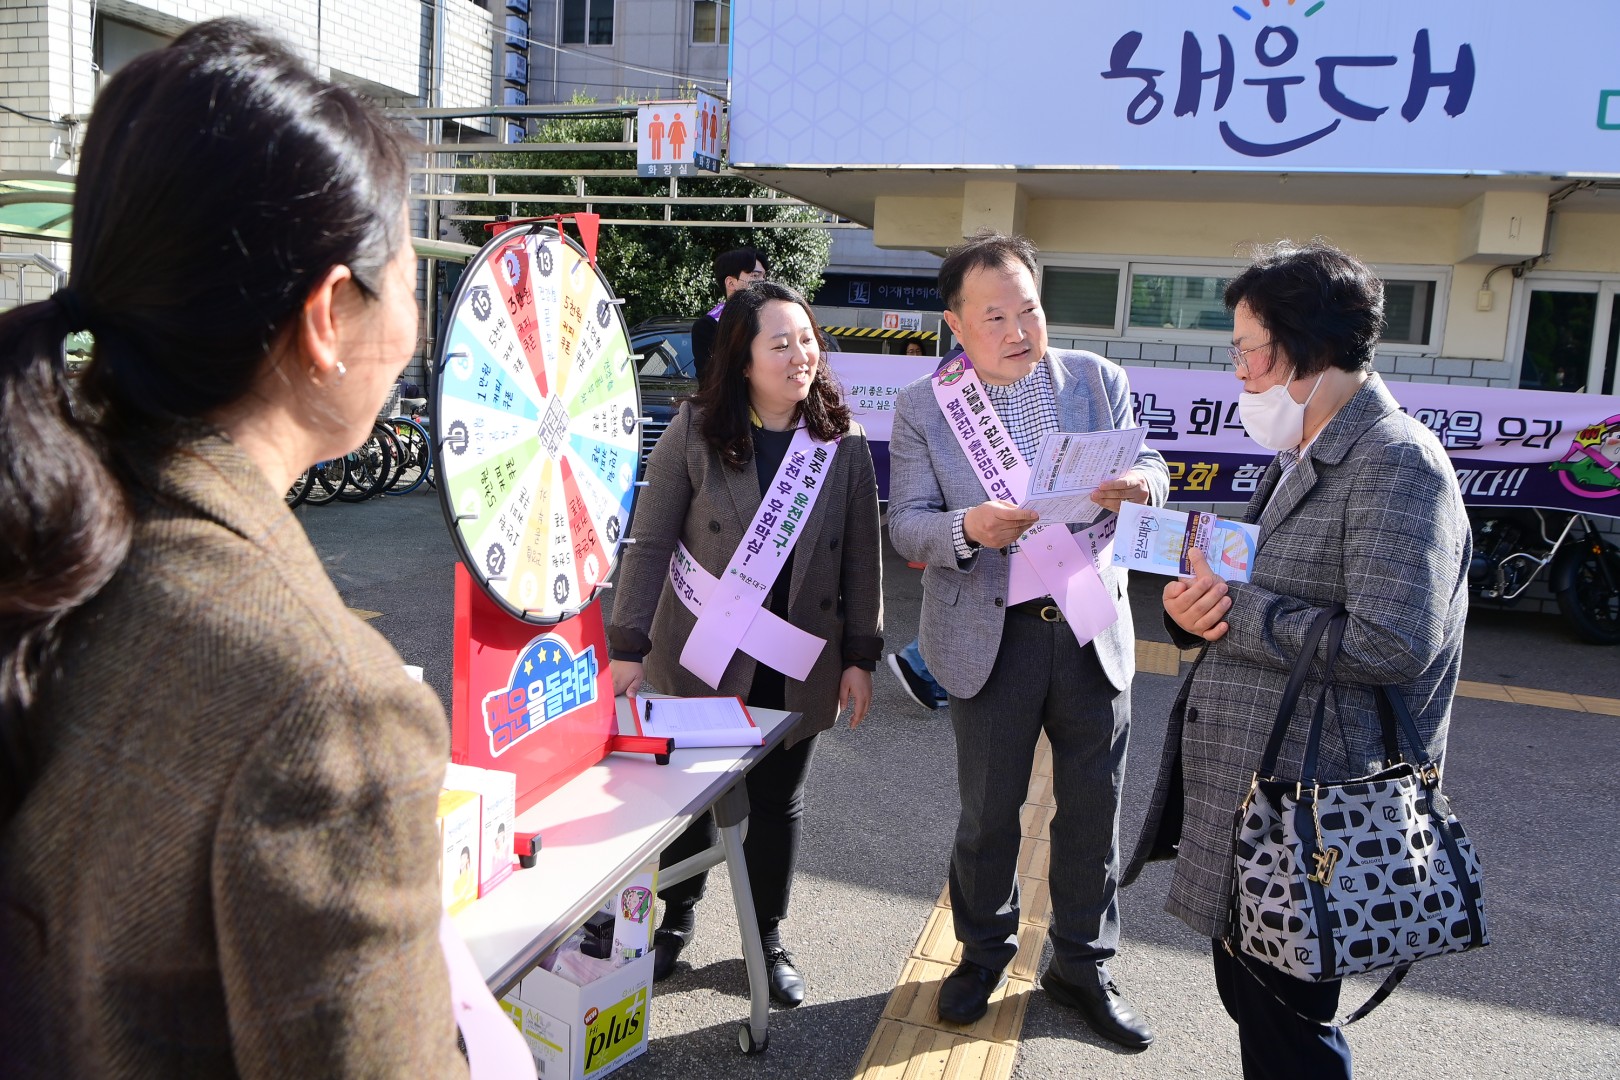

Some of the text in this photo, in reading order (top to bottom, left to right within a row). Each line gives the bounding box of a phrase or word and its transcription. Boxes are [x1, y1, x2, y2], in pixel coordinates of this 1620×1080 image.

[1101, 25, 1475, 157] 해운대
[647, 164, 688, 175] 화장실
[539, 250, 551, 267] 13
[508, 262, 516, 279] 2
[475, 292, 490, 312] 15
[878, 285, 942, 306] 이재현헤어
[563, 295, 583, 324] 5천원
[517, 319, 532, 334] 커피
[562, 320, 575, 337] 커피
[503, 343, 515, 361] 커피
[522, 338, 537, 352] 쿠폰
[560, 337, 571, 355] 쿠폰
[513, 359, 525, 374] 쿠폰
[476, 362, 492, 402] 1만원
[493, 379, 503, 404] 커피
[851, 386, 866, 396] 살기
[868, 386, 883, 396] 좋은
[502, 390, 514, 410] 쿠폰
[859, 400, 874, 409] 오고
[876, 400, 891, 410] 싶은
[623, 416, 634, 427] 9
[961, 382, 1019, 471] 되돌릴 수 없는 것은
[946, 398, 976, 441] 엎질러진
[968, 438, 1000, 480] 술잔만이
[1495, 416, 1562, 449] 우리
[591, 445, 601, 464] 쿠폰
[599, 448, 608, 472] 커피
[808, 447, 828, 474] 음주
[505, 457, 517, 479] 쿠폰
[606, 448, 619, 483] 1만원
[481, 467, 497, 508] 5천원
[494, 465, 506, 492] 커피
[801, 475, 817, 490] 후
[518, 486, 531, 510] 쿠폰
[569, 495, 583, 515] 쿠폰
[509, 504, 524, 525] 커피
[742, 451, 806, 566] 운전 후 후회막심!
[554, 513, 565, 527] 쿠폰
[572, 516, 588, 536] 커피
[607, 521, 620, 538] 14
[499, 514, 521, 547] 1만원
[555, 534, 567, 546] 커피
[1133, 515, 1157, 560] 알쓰패치
[574, 528, 597, 559] 3만원
[488, 549, 504, 568] 12
[552, 552, 571, 567] 5천원
[588, 565, 597, 578] 1
[555, 579, 568, 596] 16
[585, 1011, 641, 1070] plus
[588, 1024, 599, 1037] Hi
